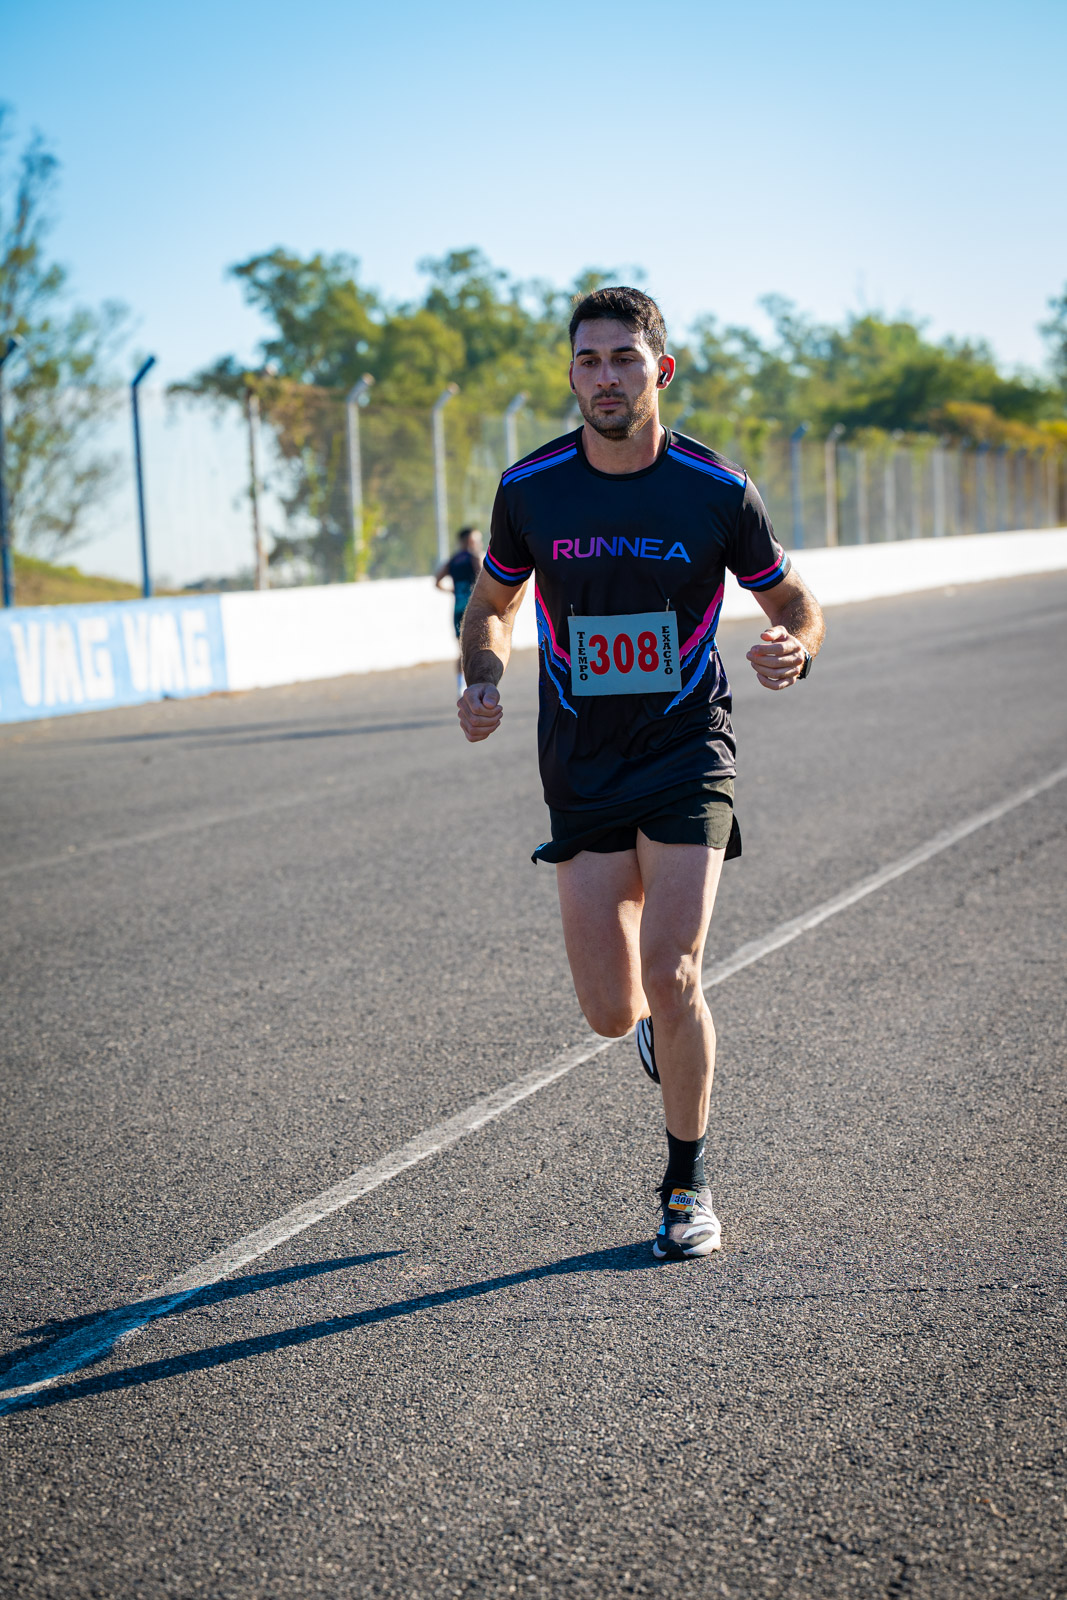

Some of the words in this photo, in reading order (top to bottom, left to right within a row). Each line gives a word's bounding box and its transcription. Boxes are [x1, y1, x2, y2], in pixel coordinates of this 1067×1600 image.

[552, 536, 692, 563] RUNNEA
[10, 618, 115, 707] VMG
[576, 631, 588, 681] TIEMPO
[588, 631, 659, 675] 308
[661, 625, 673, 675] EXACTO
[674, 1195, 691, 1205] 308
